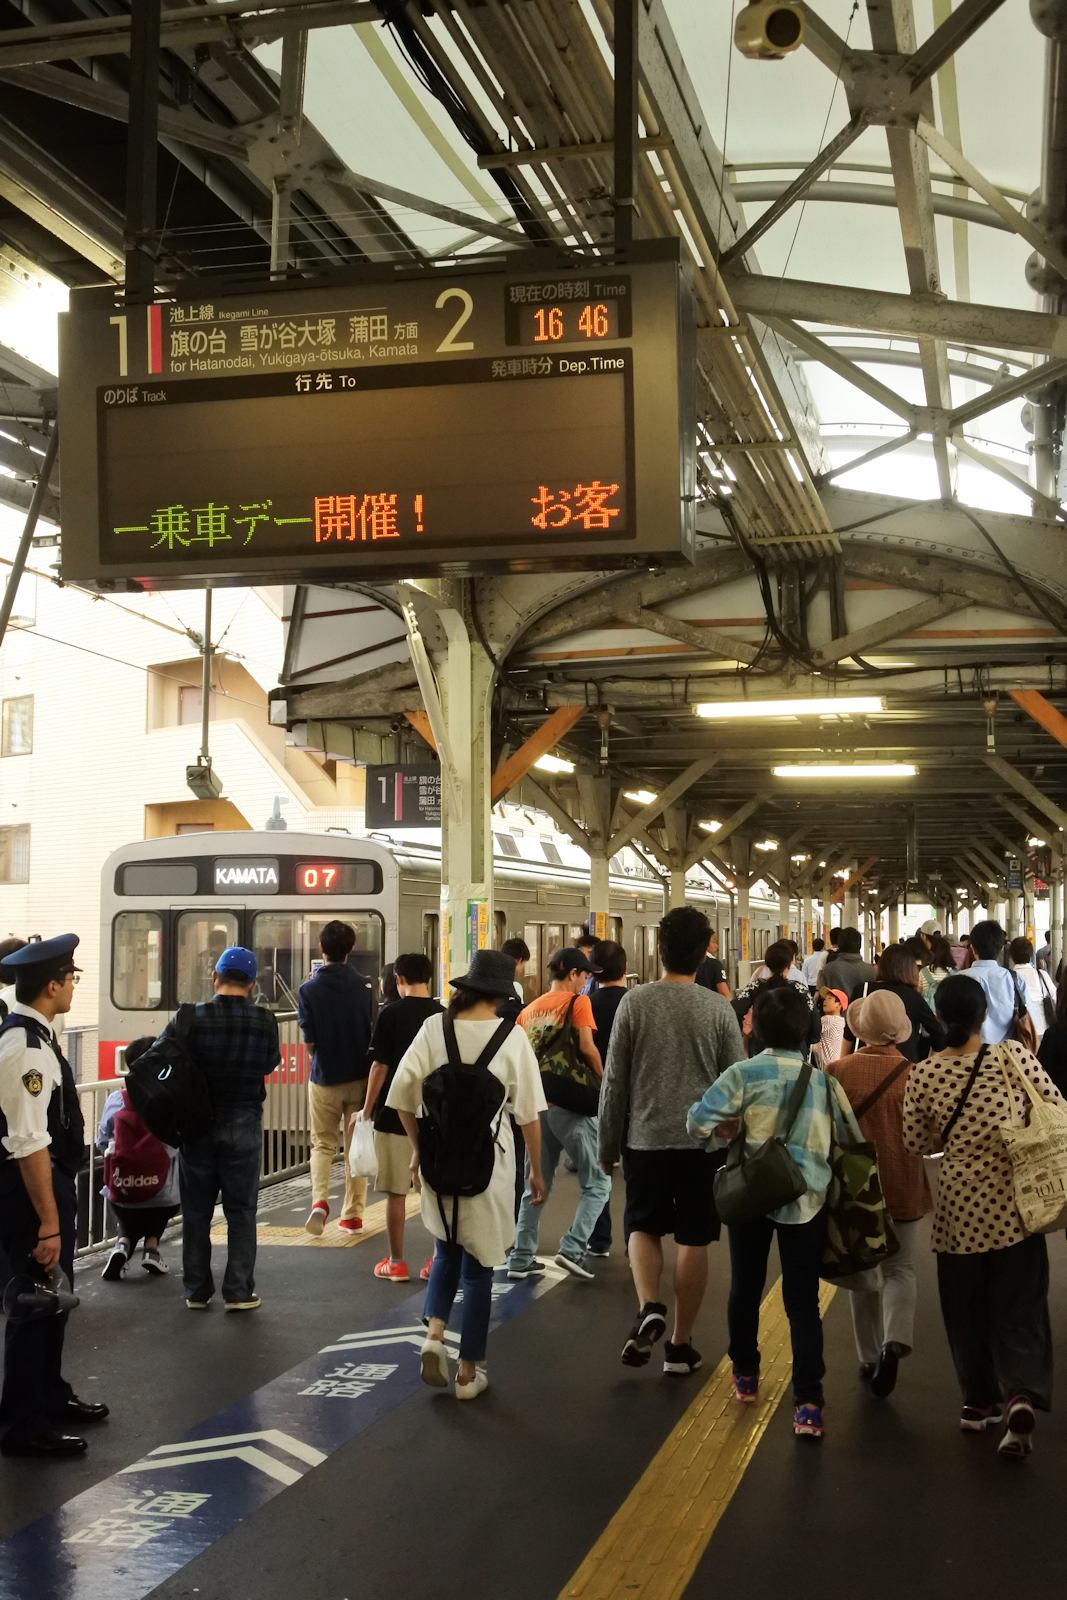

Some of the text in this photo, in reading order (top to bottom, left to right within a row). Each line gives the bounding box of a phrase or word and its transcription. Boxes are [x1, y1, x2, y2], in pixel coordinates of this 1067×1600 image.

[510, 280, 627, 303] 現在の時刻 Time
[169, 304, 269, 323] 池上線 Ikegami Line
[435, 287, 475, 353] 2
[533, 304, 608, 342] 16 46
[109, 315, 128, 376] 1
[170, 314, 418, 358] 旗の台 雪が谷大塚 蒲田 方面
[170, 361, 187, 373] for
[189, 355, 256, 372] Hatanodai,
[369, 343, 418, 358] Kamata
[491, 356, 625, 378] 発車時分 Dep.Time
[339, 375, 356, 388] To
[103, 387, 167, 405] のりば Track
[530, 480, 621, 530] お客
[377, 776, 387, 803] 1
[215, 867, 278, 884] KAMATA
[304, 868, 336, 888] 07
[114, 1174, 159, 1189] adidas
[297, 1362, 399, 1399] 通路
[61, 1489, 213, 1549] 通路
